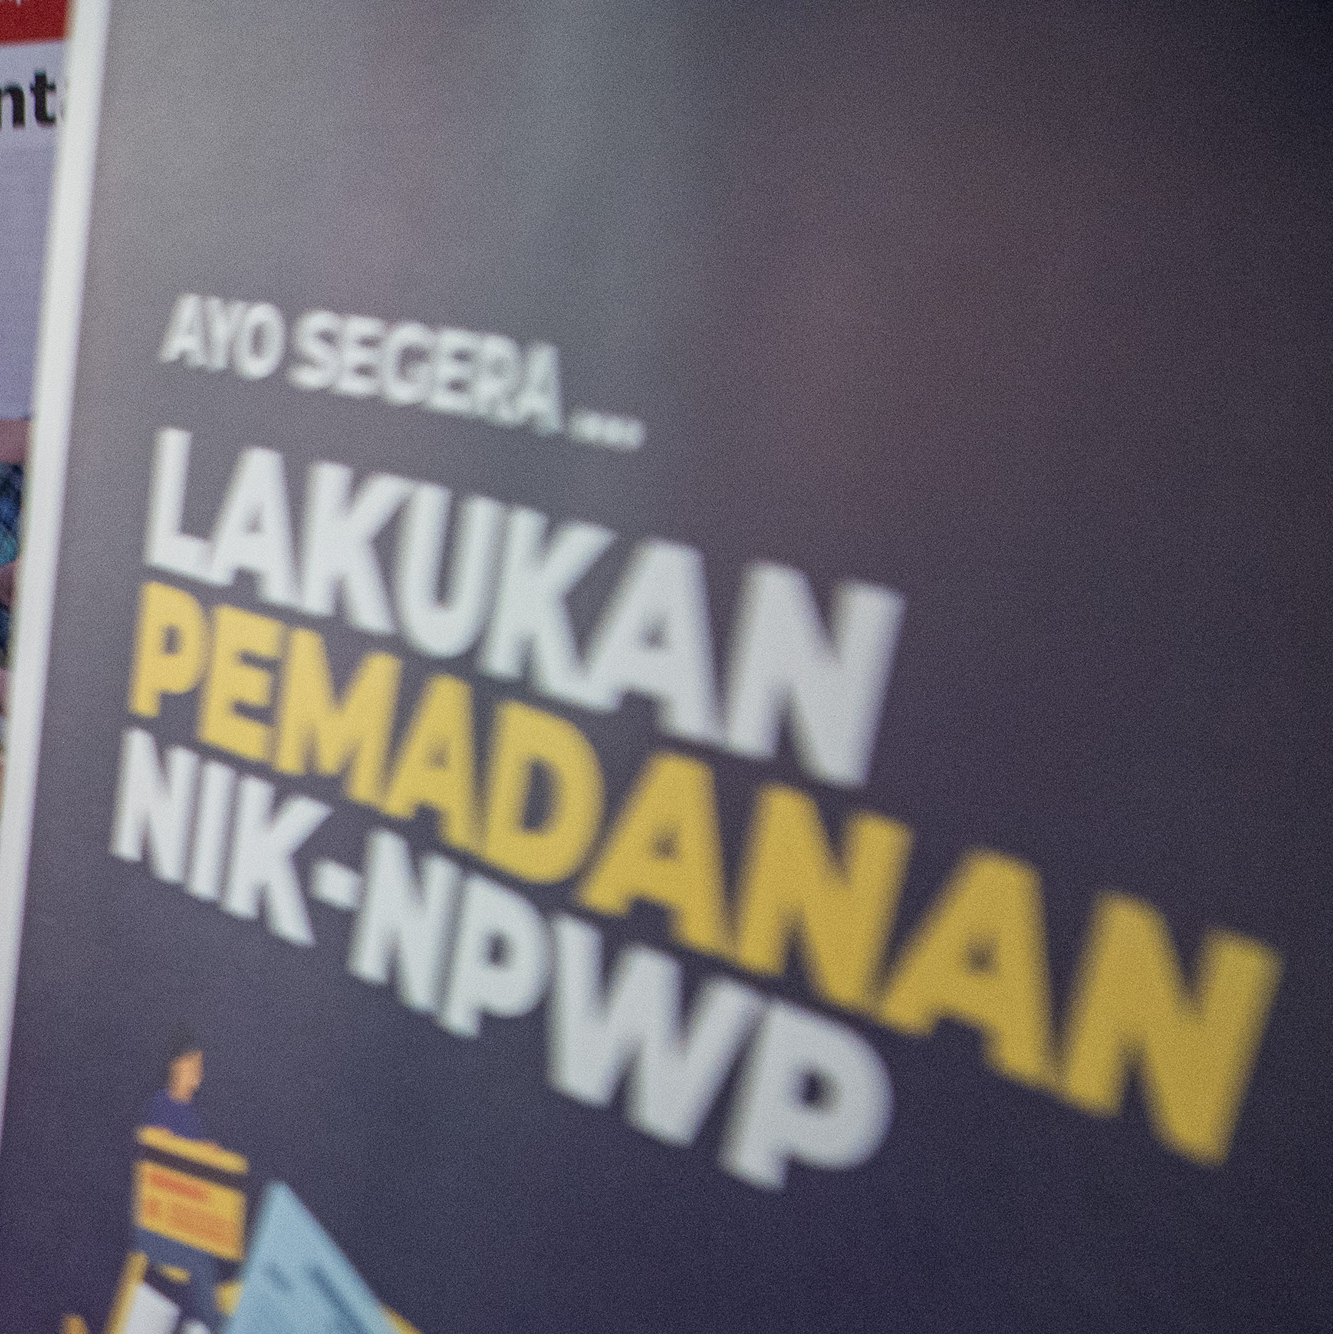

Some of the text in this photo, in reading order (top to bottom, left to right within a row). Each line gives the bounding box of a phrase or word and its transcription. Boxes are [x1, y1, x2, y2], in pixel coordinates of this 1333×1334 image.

[160, 293, 287, 380] AYO
[143, 426, 906, 789] LAKUKAN
[111, 728, 894, 1191] NIK-NPWP
[129, 580, 1282, 1168] PEMADANAN
